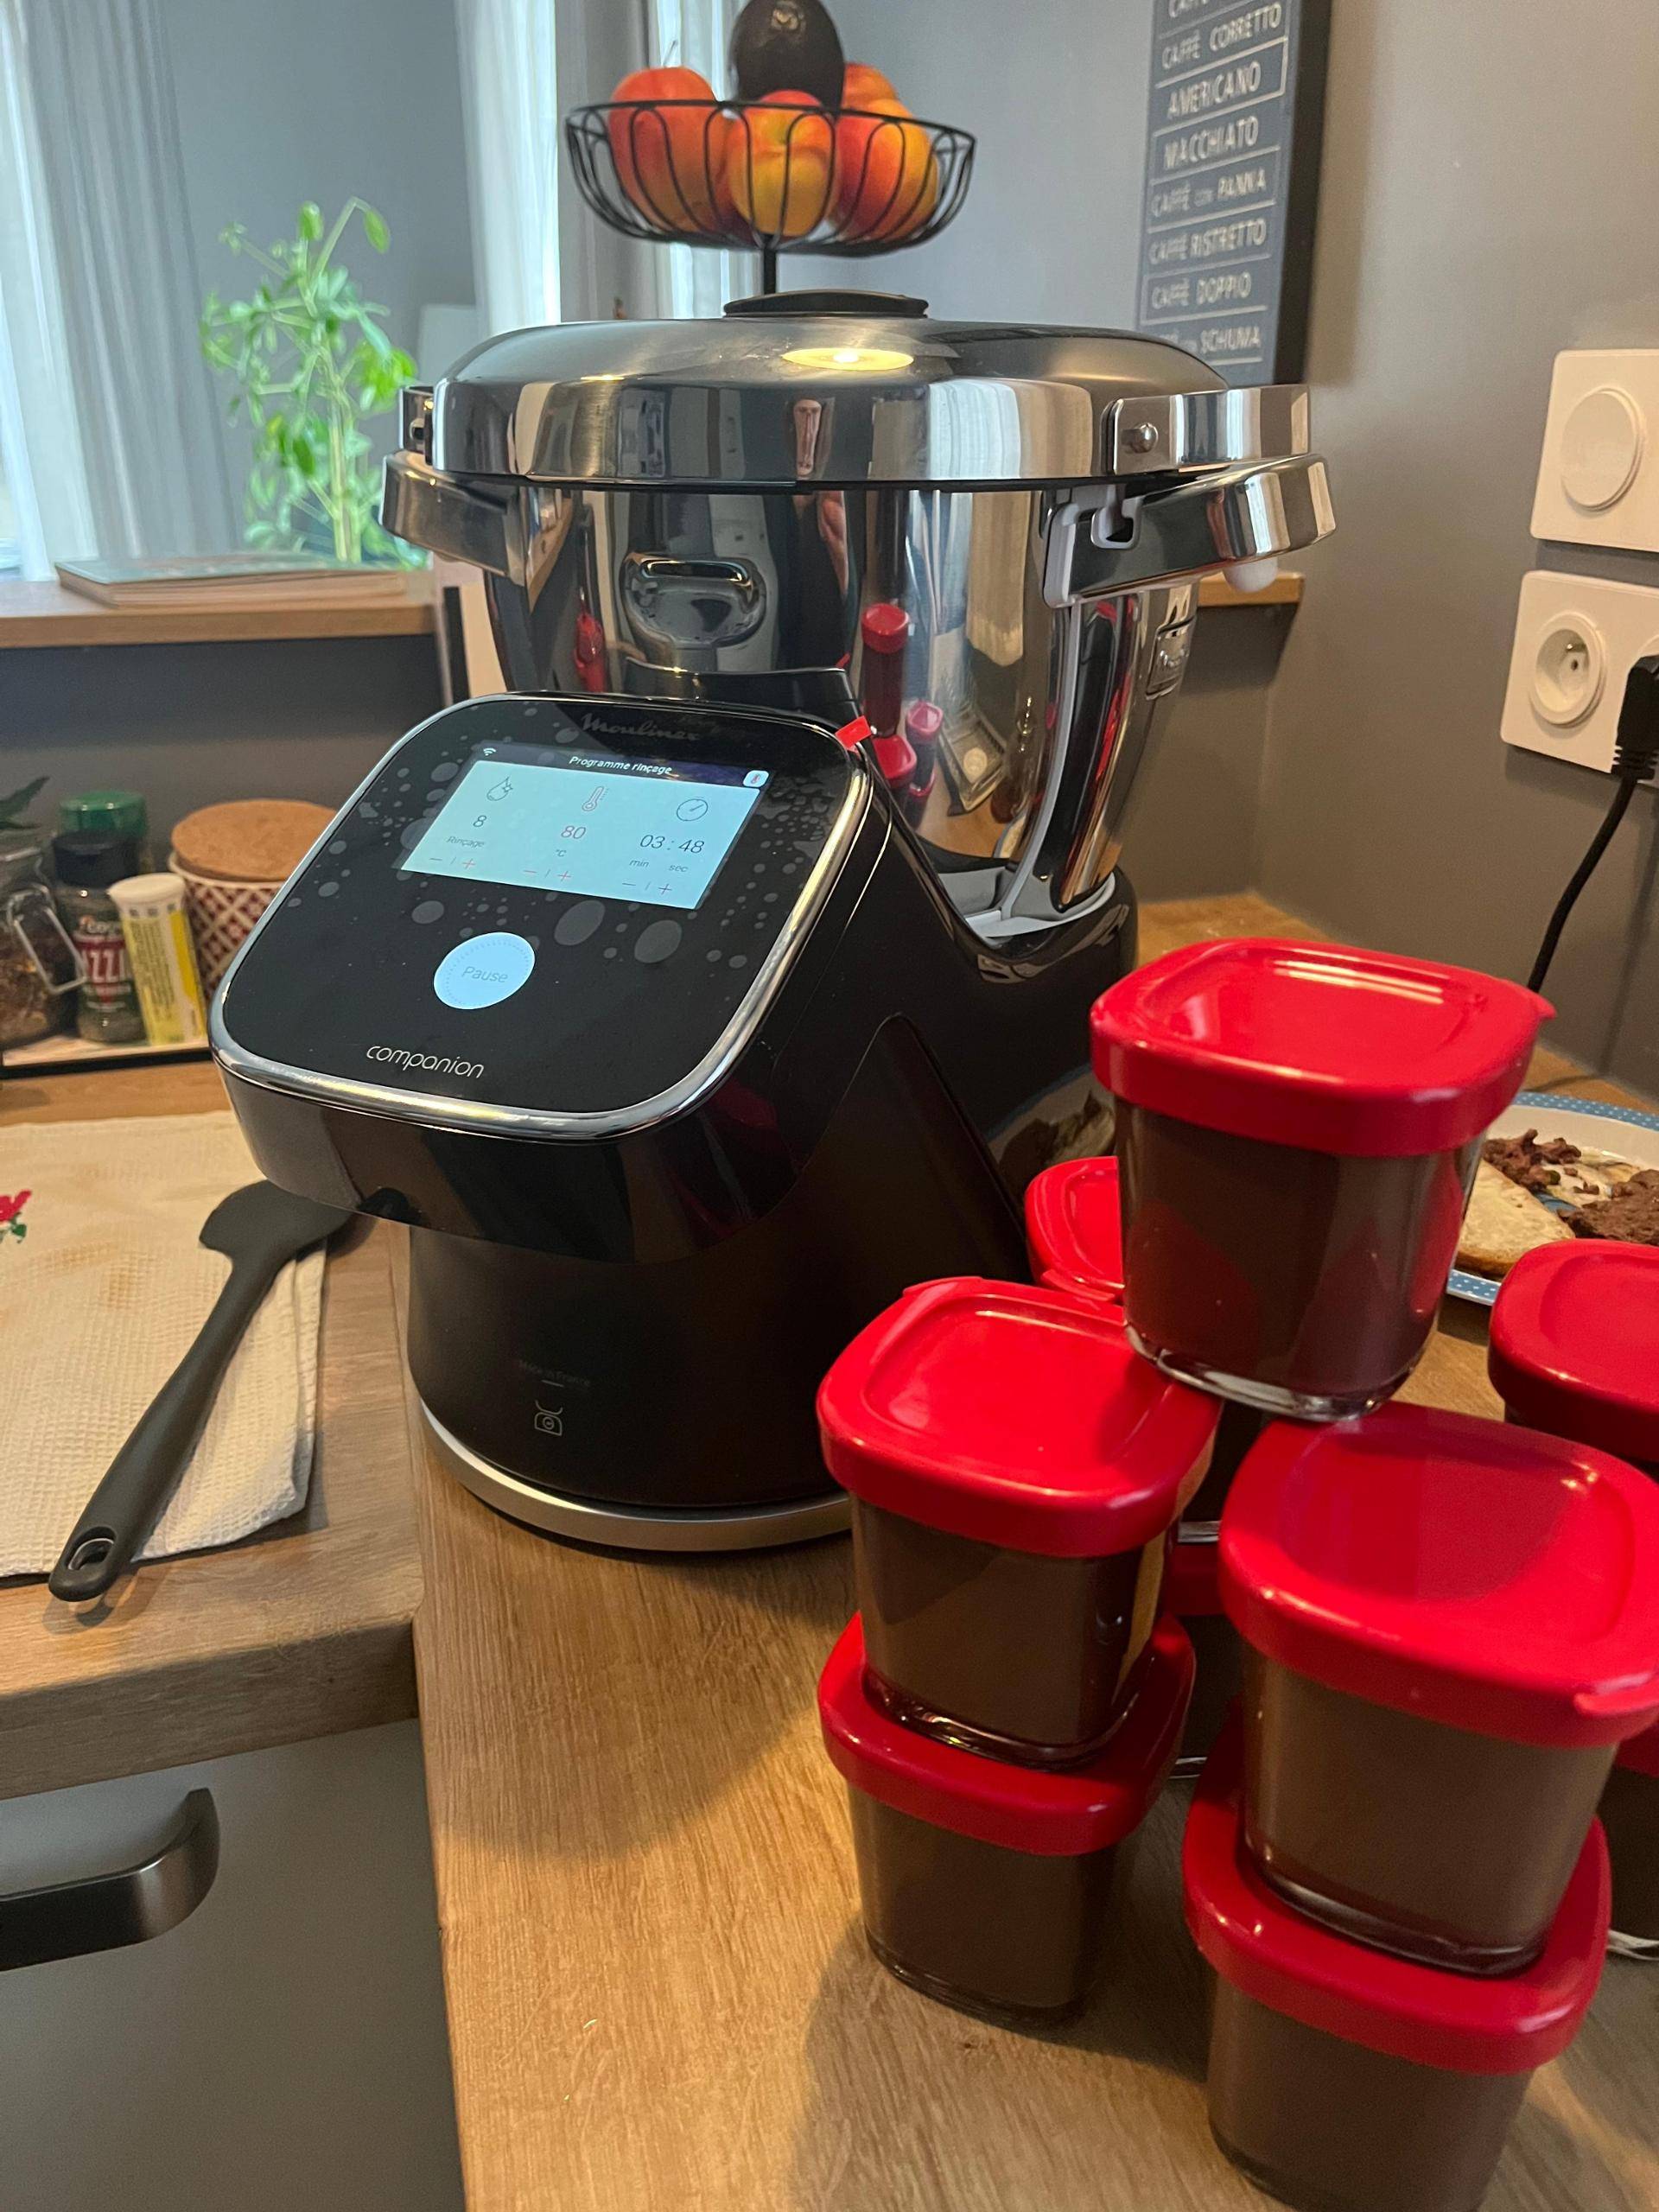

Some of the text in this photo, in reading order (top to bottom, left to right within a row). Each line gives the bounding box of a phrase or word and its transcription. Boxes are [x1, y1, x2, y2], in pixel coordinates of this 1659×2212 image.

[1209, 2, 1282, 52] CORRETTO
[1167, 60, 1262, 120] AMERICANO
[1164, 115, 1259, 170] MACCHIATO
[1218, 168, 1266, 200] PANNA
[1189, 217, 1268, 258] RISTRETTO
[1196, 270, 1252, 306] DOPPIO
[581, 712, 700, 741] Moulinex
[569, 756, 673, 776] Programme rinçage
[472, 814, 488, 829] 8
[560, 824, 588, 840] 80
[446, 836, 485, 849] Rinçage
[628, 858, 690, 874] min sec
[461, 966, 509, 983] Pause
[366, 1046, 485, 1078] companion
